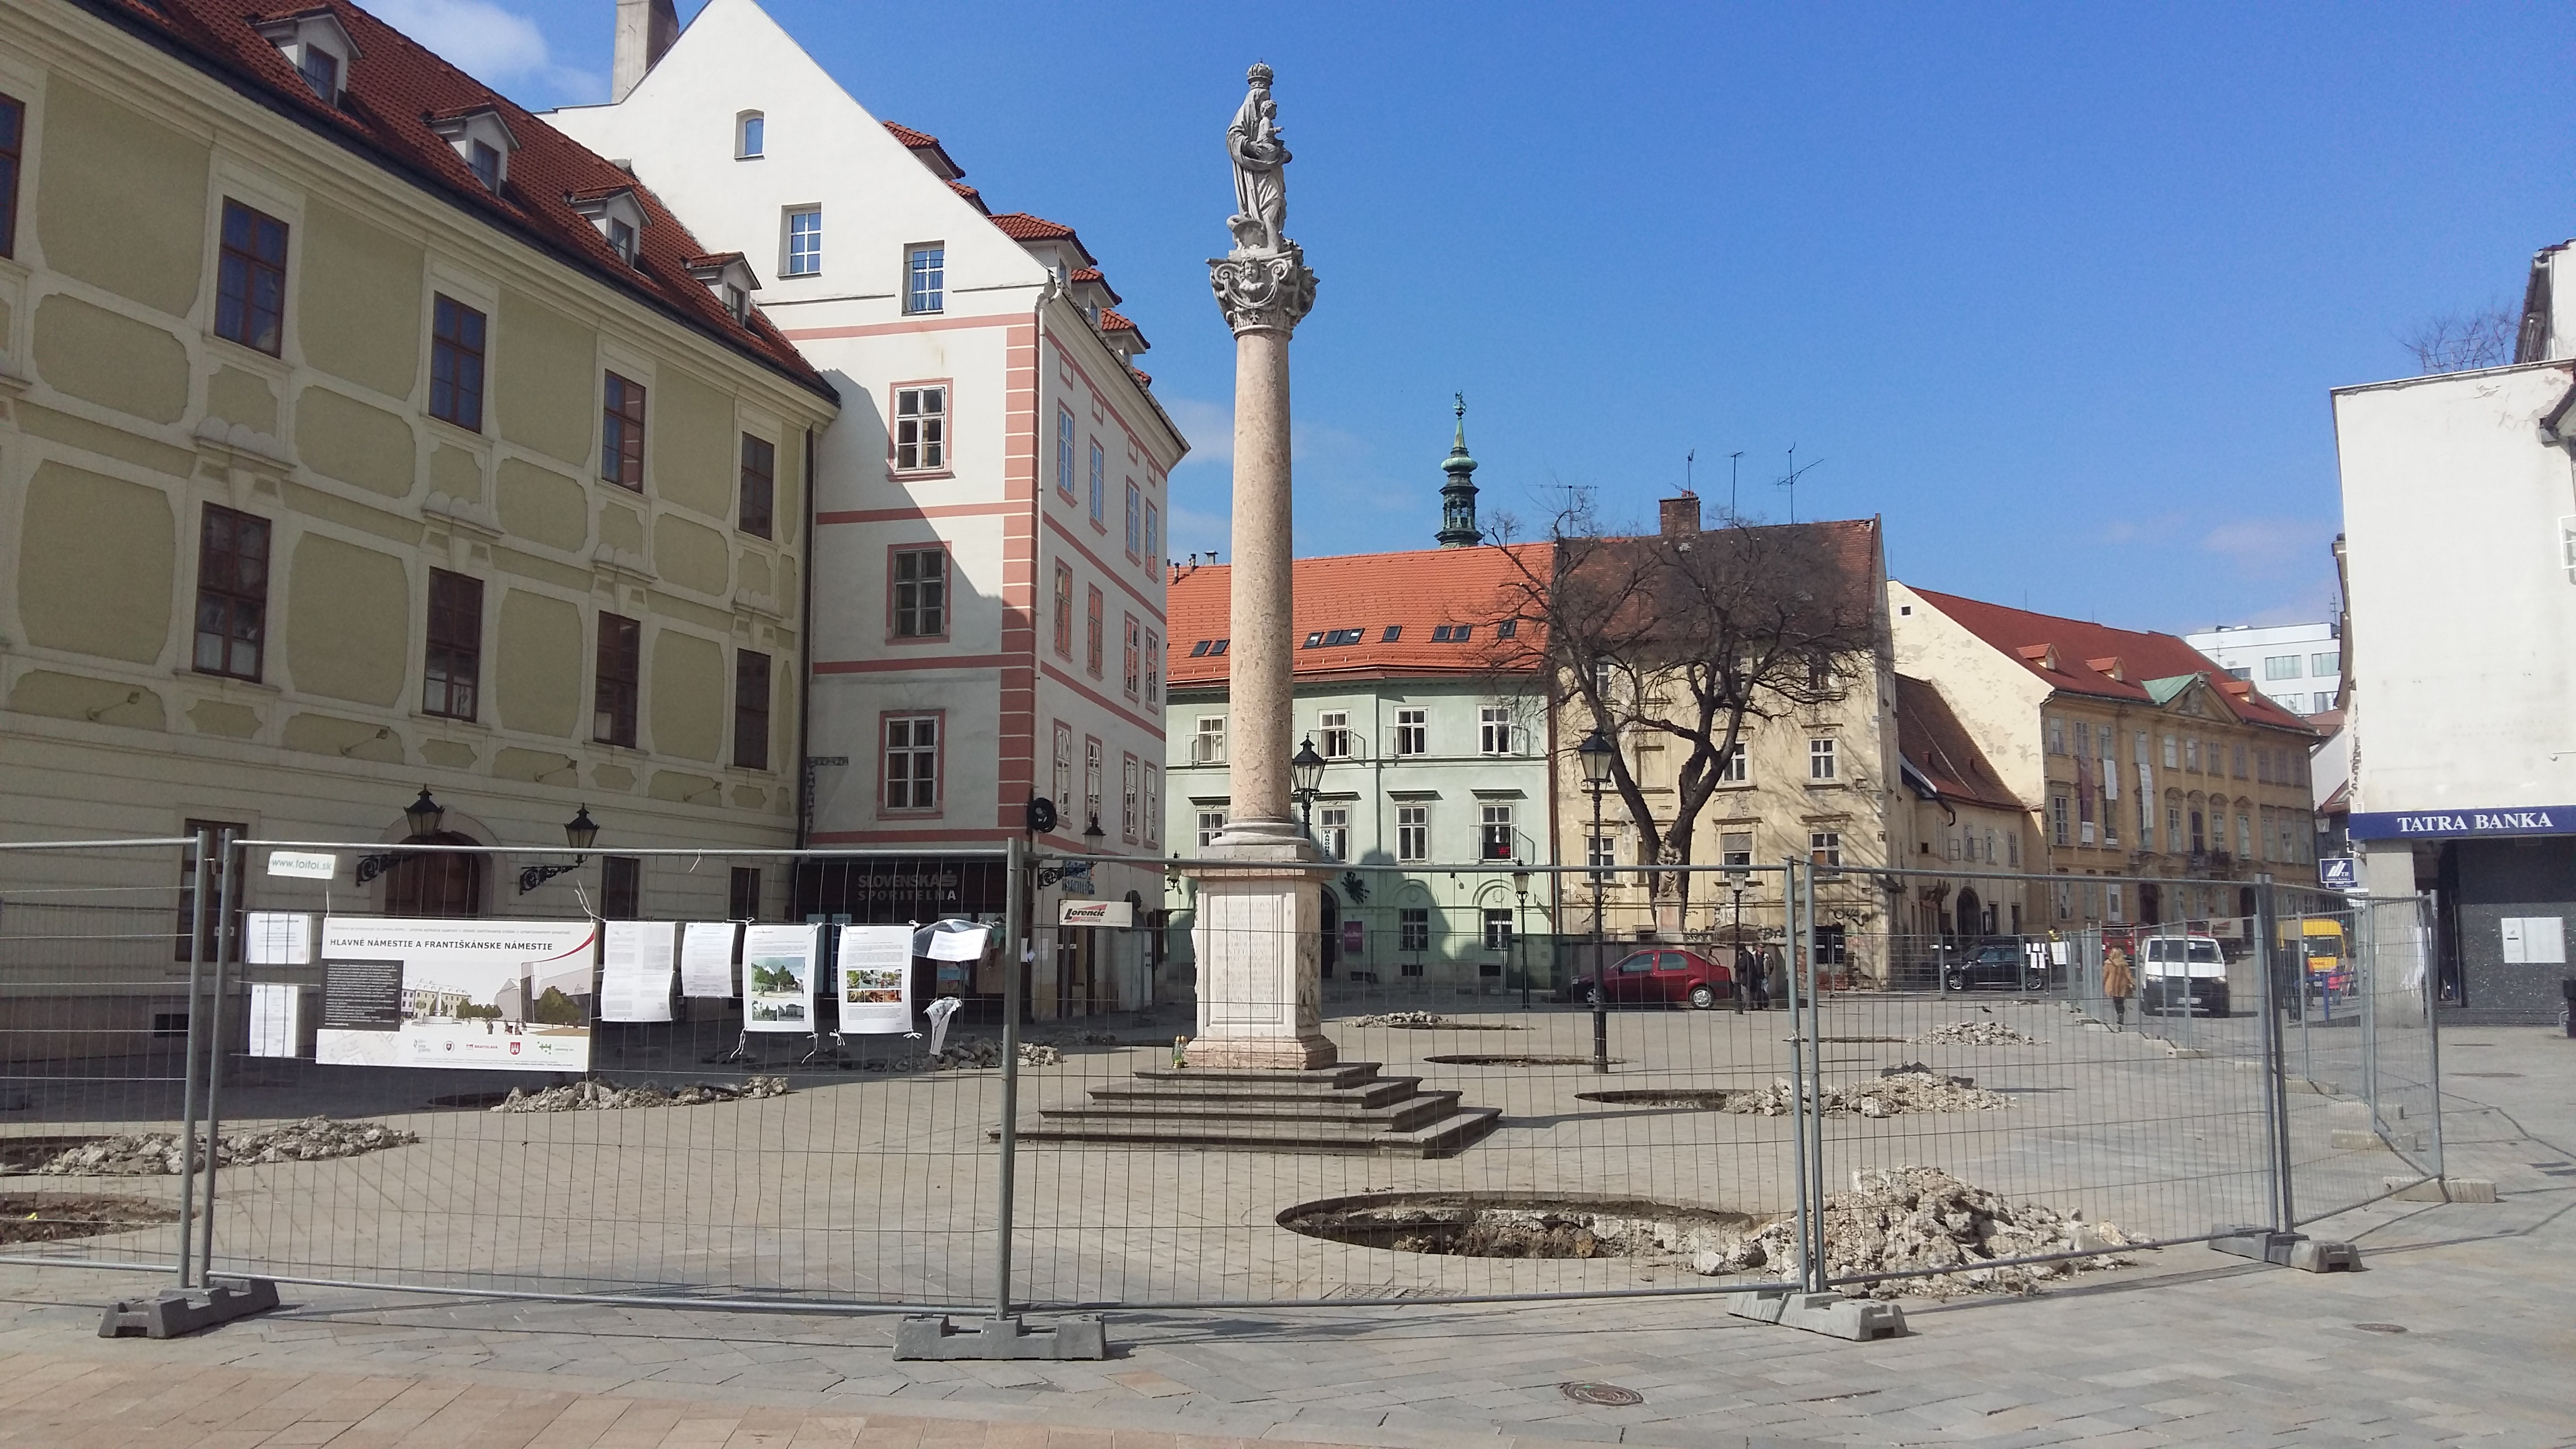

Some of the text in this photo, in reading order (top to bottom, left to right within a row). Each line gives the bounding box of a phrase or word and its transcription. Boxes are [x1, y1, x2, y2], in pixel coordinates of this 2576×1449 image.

[2397, 812, 2554, 832] TATRA BANKA
[272, 859, 332, 871] www.toitoi.sk
[1064, 908, 1105, 920] Lorencic
[330, 937, 364, 946] HLAVNÉ
[368, 938, 412, 947] NÁMESTIE
[425, 940, 501, 949] FRANTIŠKÁNSKE
[504, 940, 553, 950] NÁMESTIE
